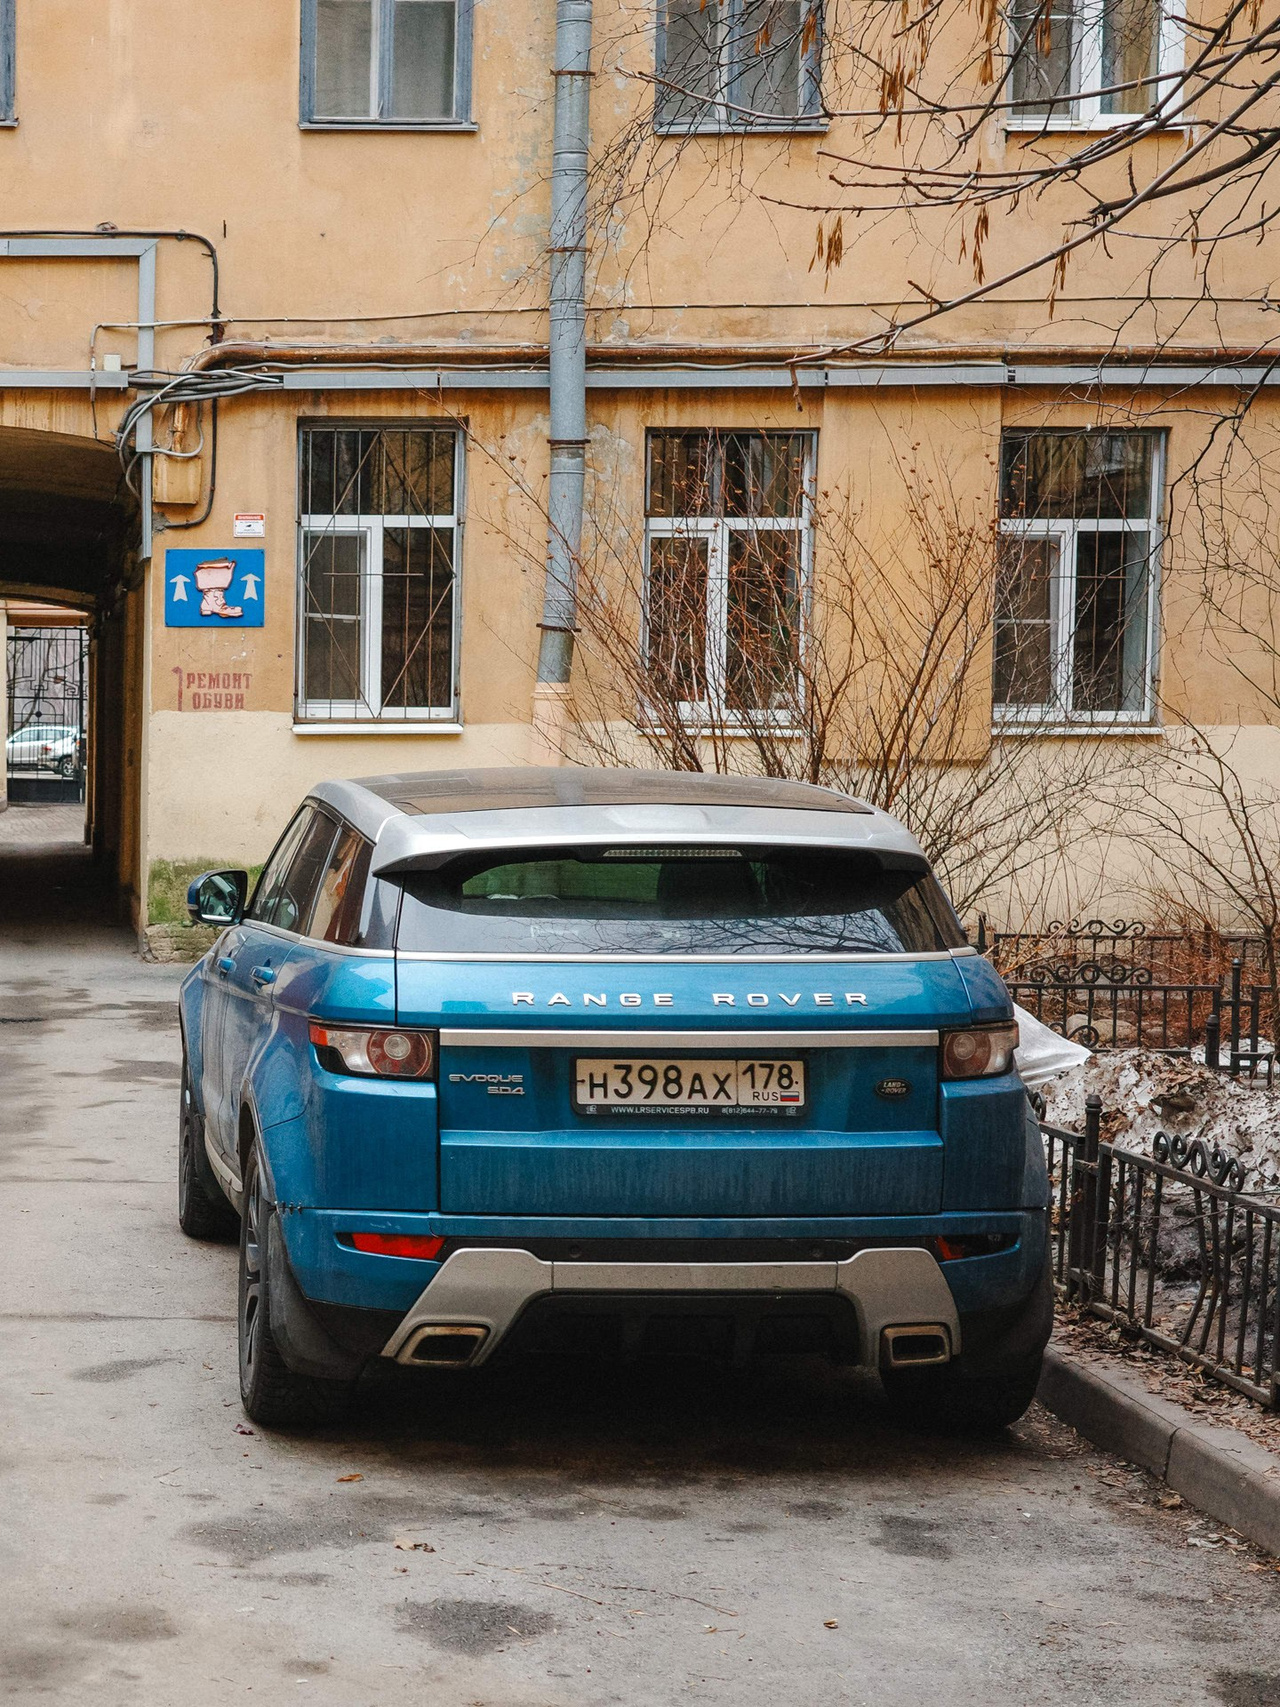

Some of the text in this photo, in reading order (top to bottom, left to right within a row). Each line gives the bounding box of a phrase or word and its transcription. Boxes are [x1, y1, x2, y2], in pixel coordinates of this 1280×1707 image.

[186, 672, 253, 690] РЕМОНТ
[192, 692, 245, 710] ОБУВИ
[512, 991, 869, 1008] RANGE ROVER
[448, 1074, 524, 1083] EVOQUE
[588, 1063, 794, 1100] Н398АХ 178
[487, 1086, 525, 1095] SD4
[752, 1091, 779, 1102] RUS
[610, 1106, 710, 1115] WWW.LRSERVICESPB.RU
